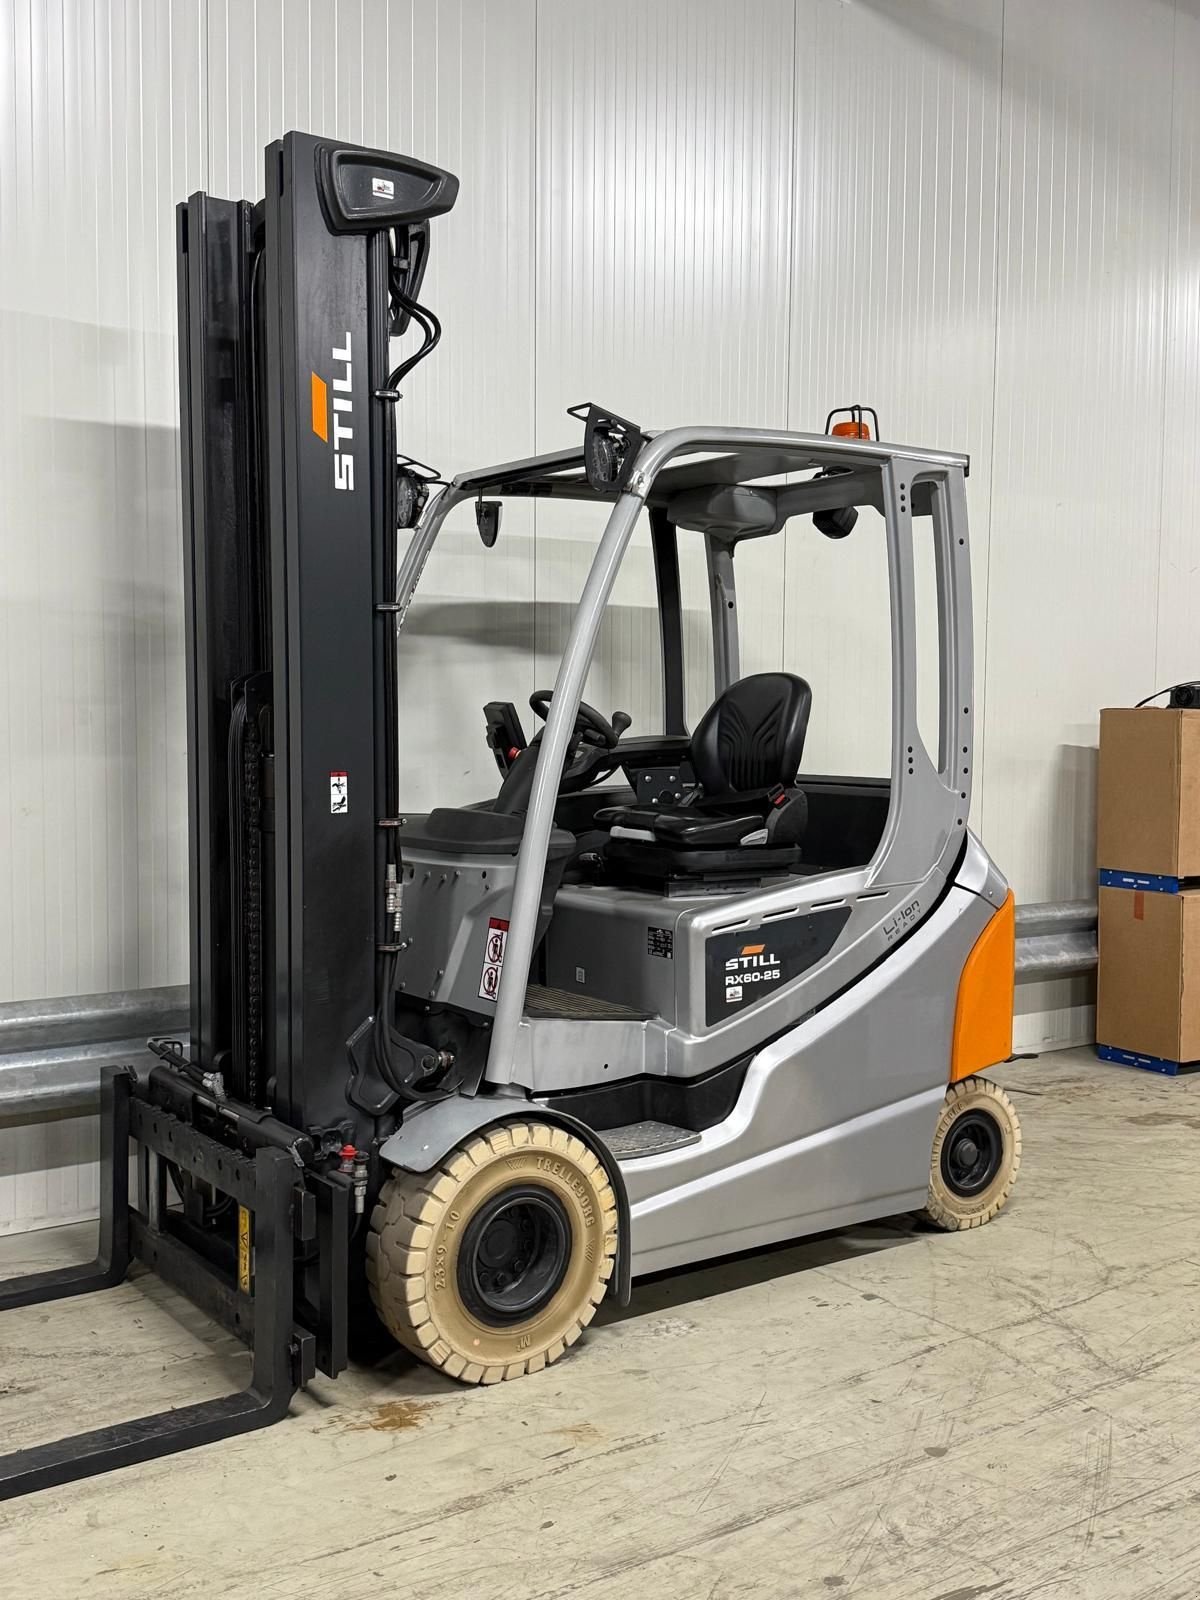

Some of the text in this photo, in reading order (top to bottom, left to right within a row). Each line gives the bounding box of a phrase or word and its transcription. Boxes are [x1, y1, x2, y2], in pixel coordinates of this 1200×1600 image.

[332, 332, 354, 491] STILL
[725, 953, 780, 971] STILL
[725, 969, 780, 986] RX60-25
[536, 1156, 595, 1228] TRELLEBORG
